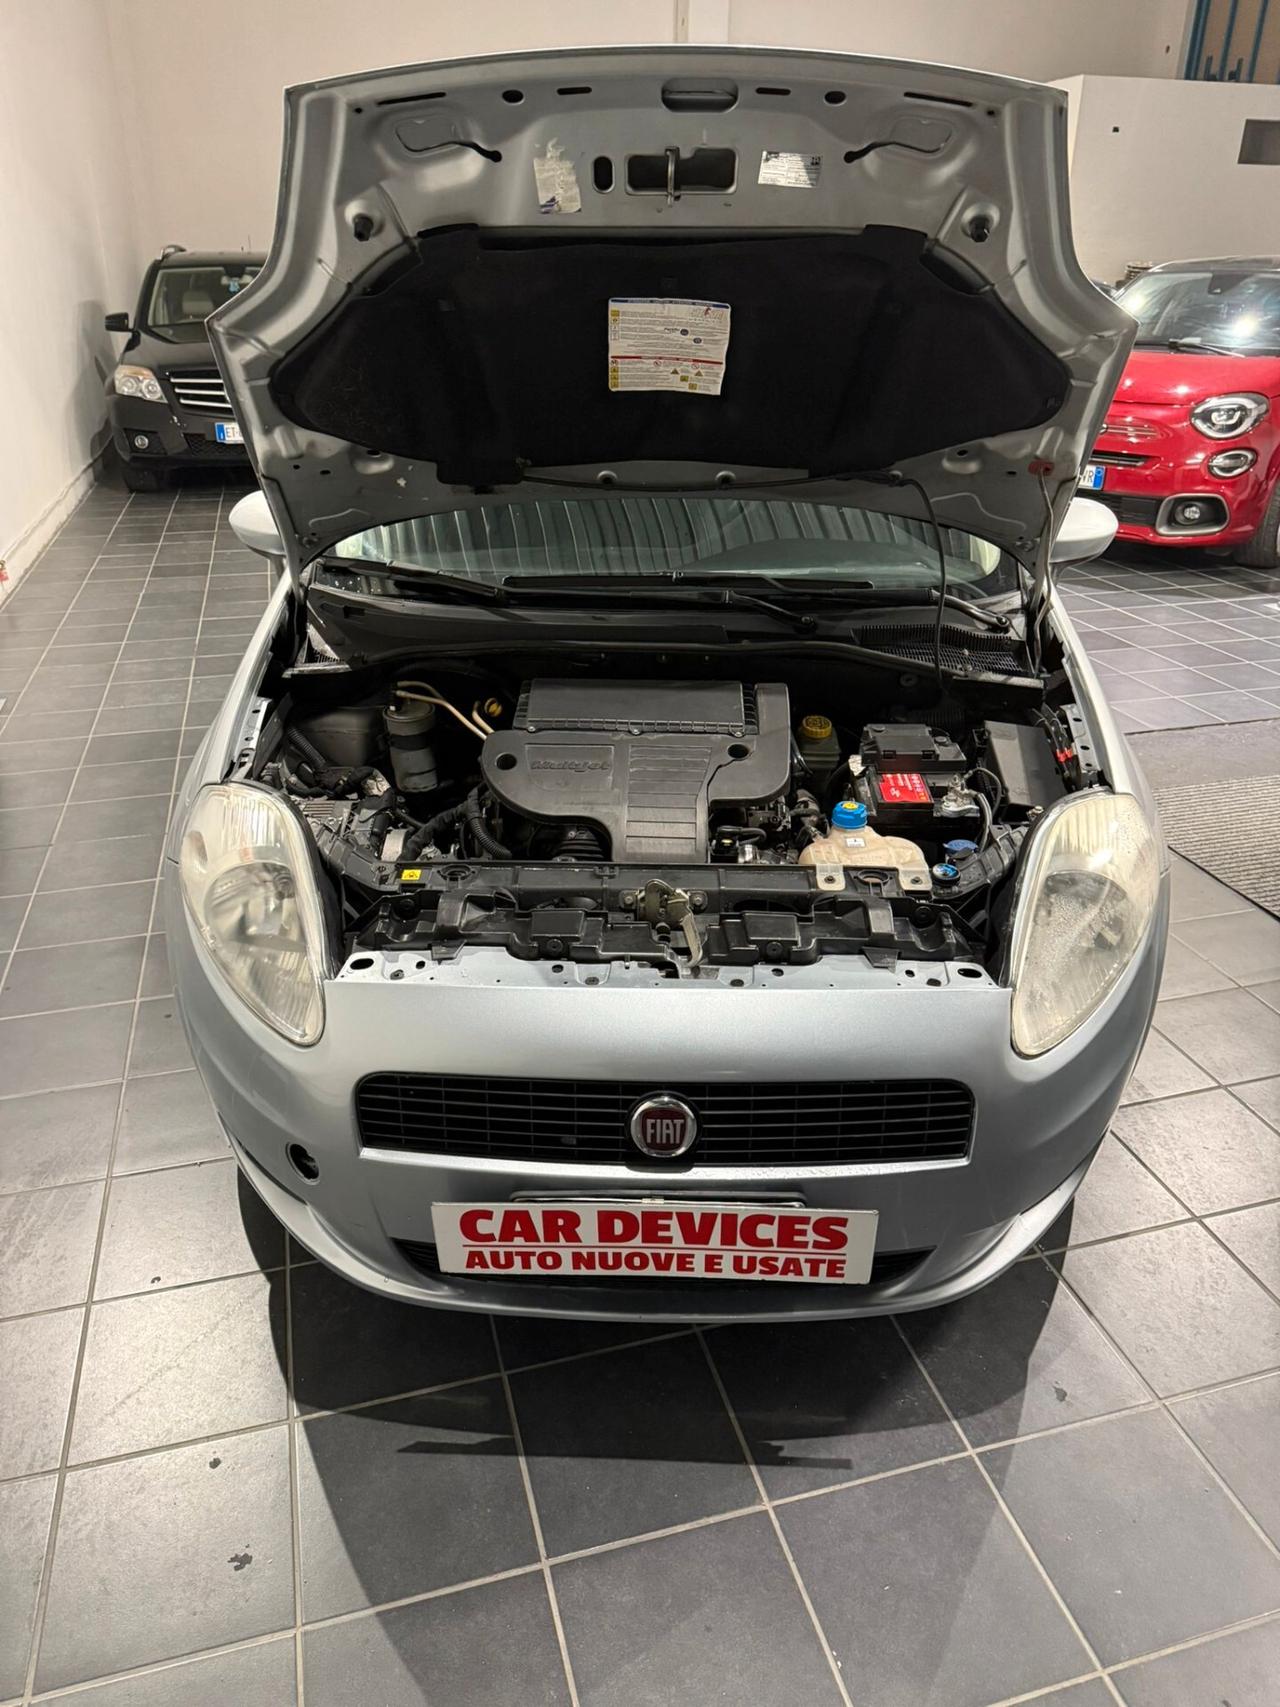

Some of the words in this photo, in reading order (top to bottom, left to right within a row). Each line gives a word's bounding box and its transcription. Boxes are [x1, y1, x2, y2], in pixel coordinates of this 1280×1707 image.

[646, 1119, 685, 1144] FIAT
[459, 1209, 582, 1243] CAR
[597, 1210, 849, 1251] DEVICES
[465, 1250, 563, 1270] AUTO
[572, 1252, 695, 1273] NUOVE
[704, 1255, 723, 1273] E
[732, 1256, 846, 1279] USATE
